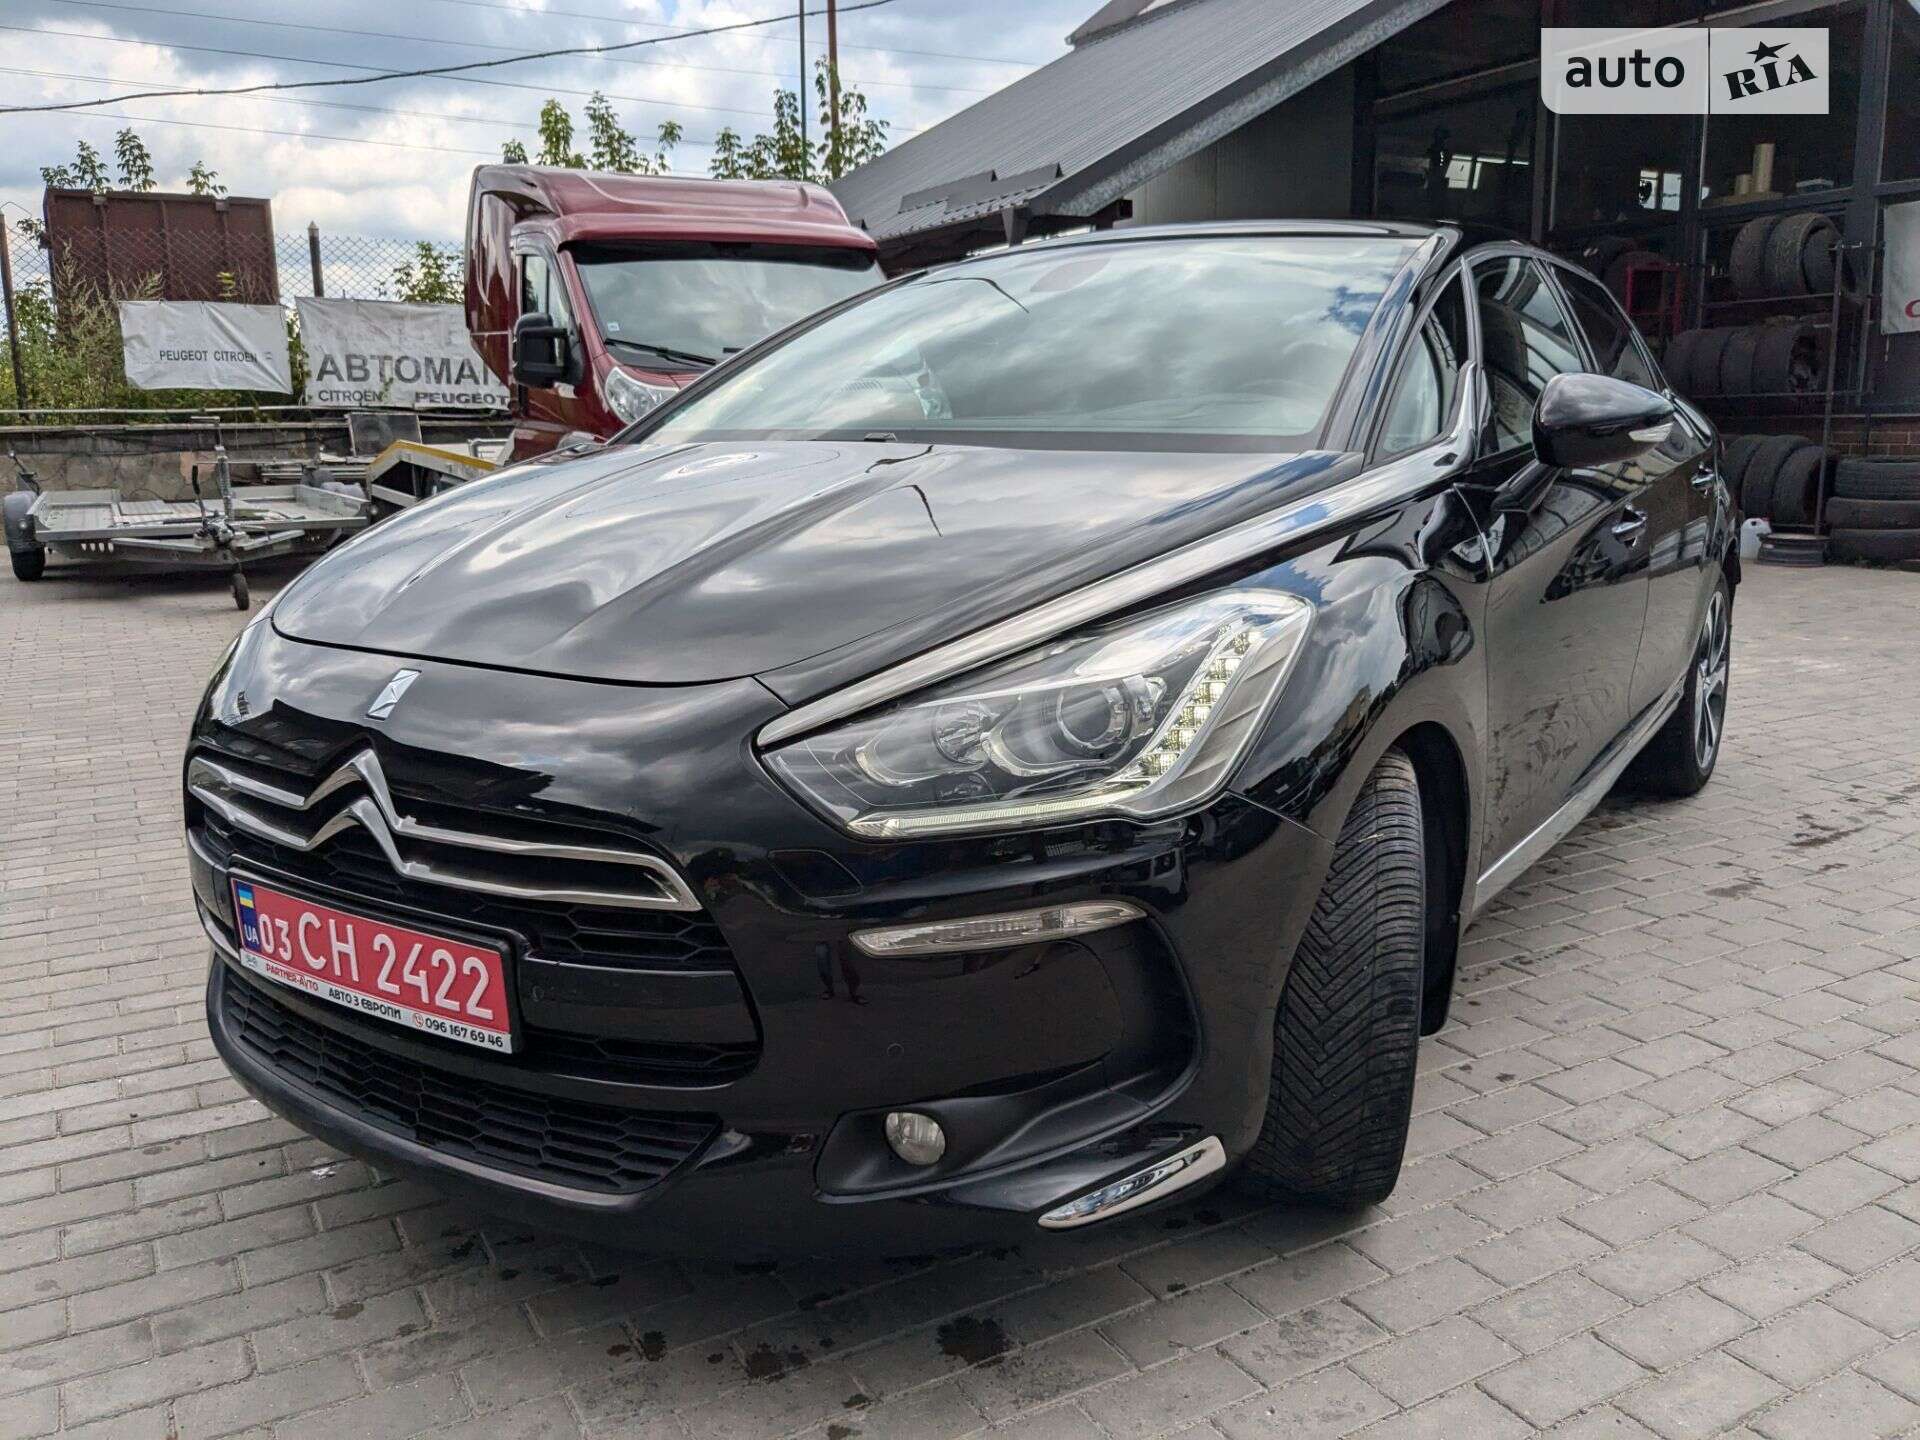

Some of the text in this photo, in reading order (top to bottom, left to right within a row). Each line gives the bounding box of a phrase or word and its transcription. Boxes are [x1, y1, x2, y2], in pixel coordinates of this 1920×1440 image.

[159, 350, 208, 361] PEUGEOT
[415, 391, 510, 407] PEUGEOT
[244, 923, 260, 945] UA
[372, 933, 494, 1020] 2422
[328, 987, 353, 1004] АВТО
[425, 1017, 504, 1048] 096 167 69 46
